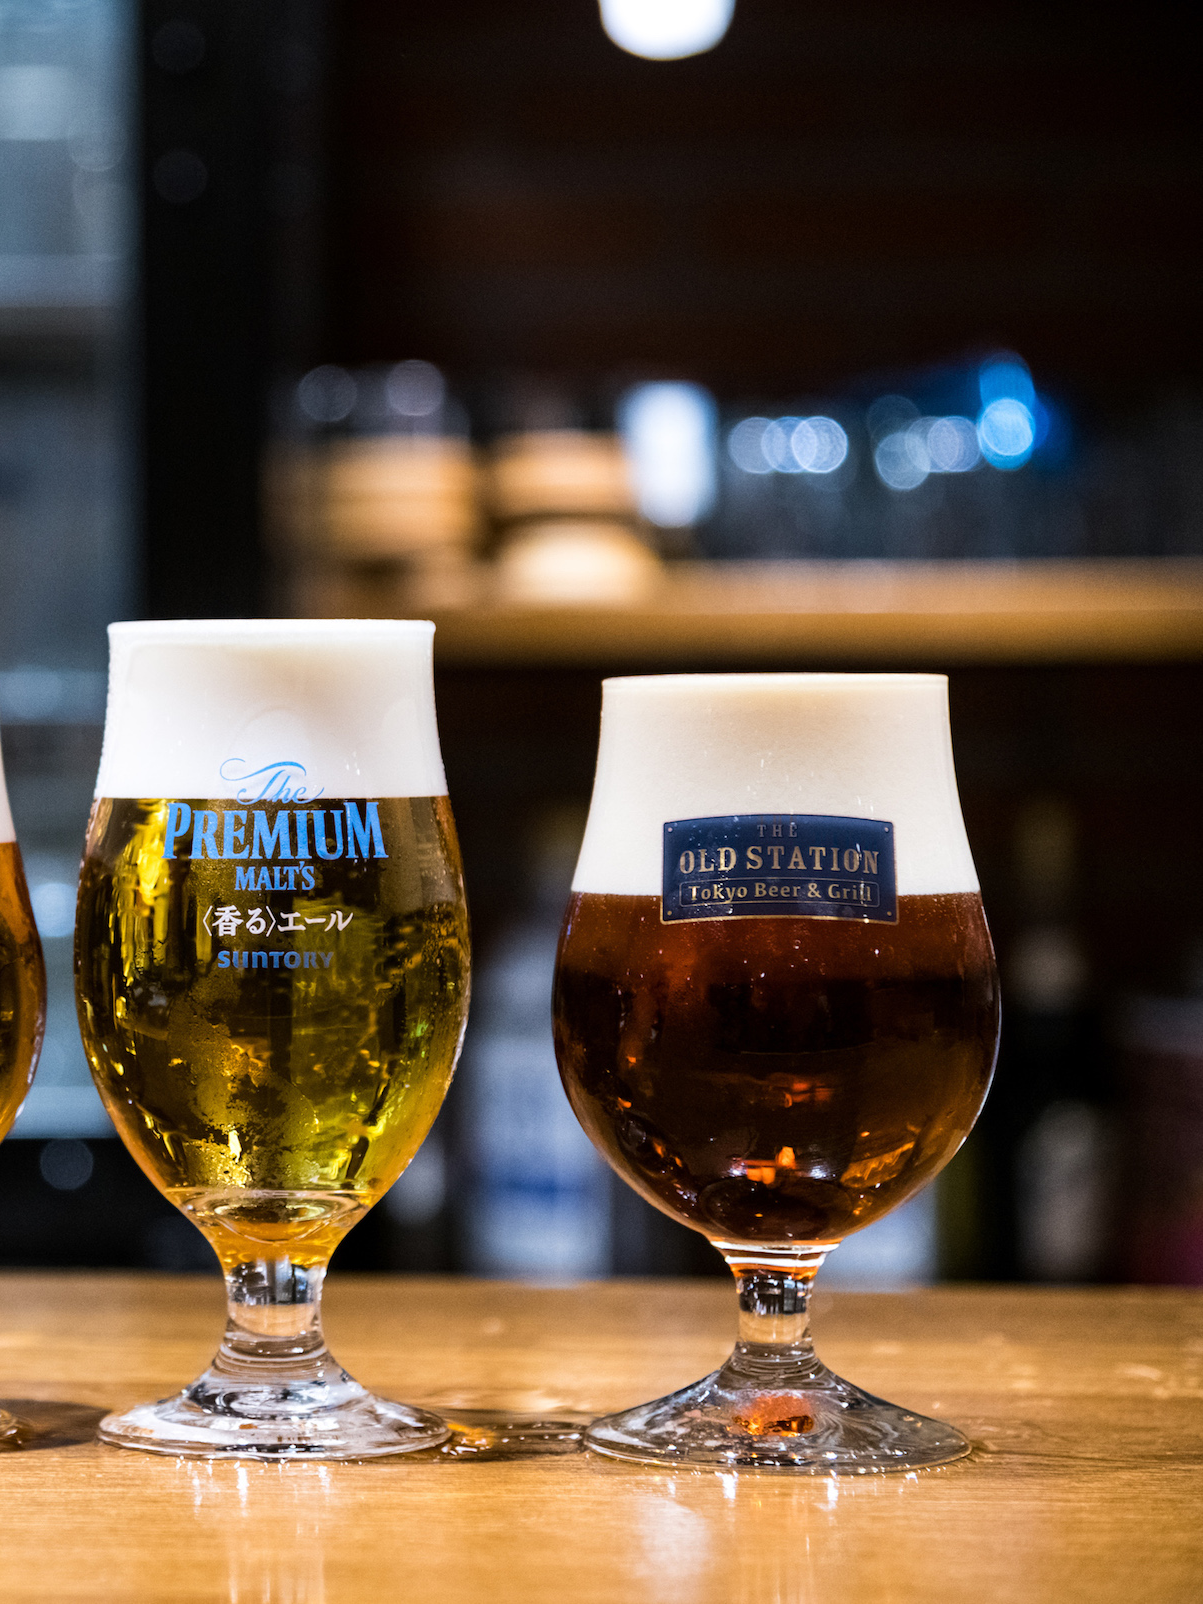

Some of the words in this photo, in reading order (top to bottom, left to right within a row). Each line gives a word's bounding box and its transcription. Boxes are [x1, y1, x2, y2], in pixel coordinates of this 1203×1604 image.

[219, 758, 325, 806] The
[161, 801, 389, 860] PREMIUM
[757, 823, 798, 838] THE
[679, 846, 737, 874] OLD
[746, 845, 880, 875] STATION
[235, 861, 316, 891] MALT'S
[688, 883, 748, 904] Tokyo
[754, 882, 801, 898] Beer
[807, 882, 821, 899] &
[828, 883, 872, 902] Grill
